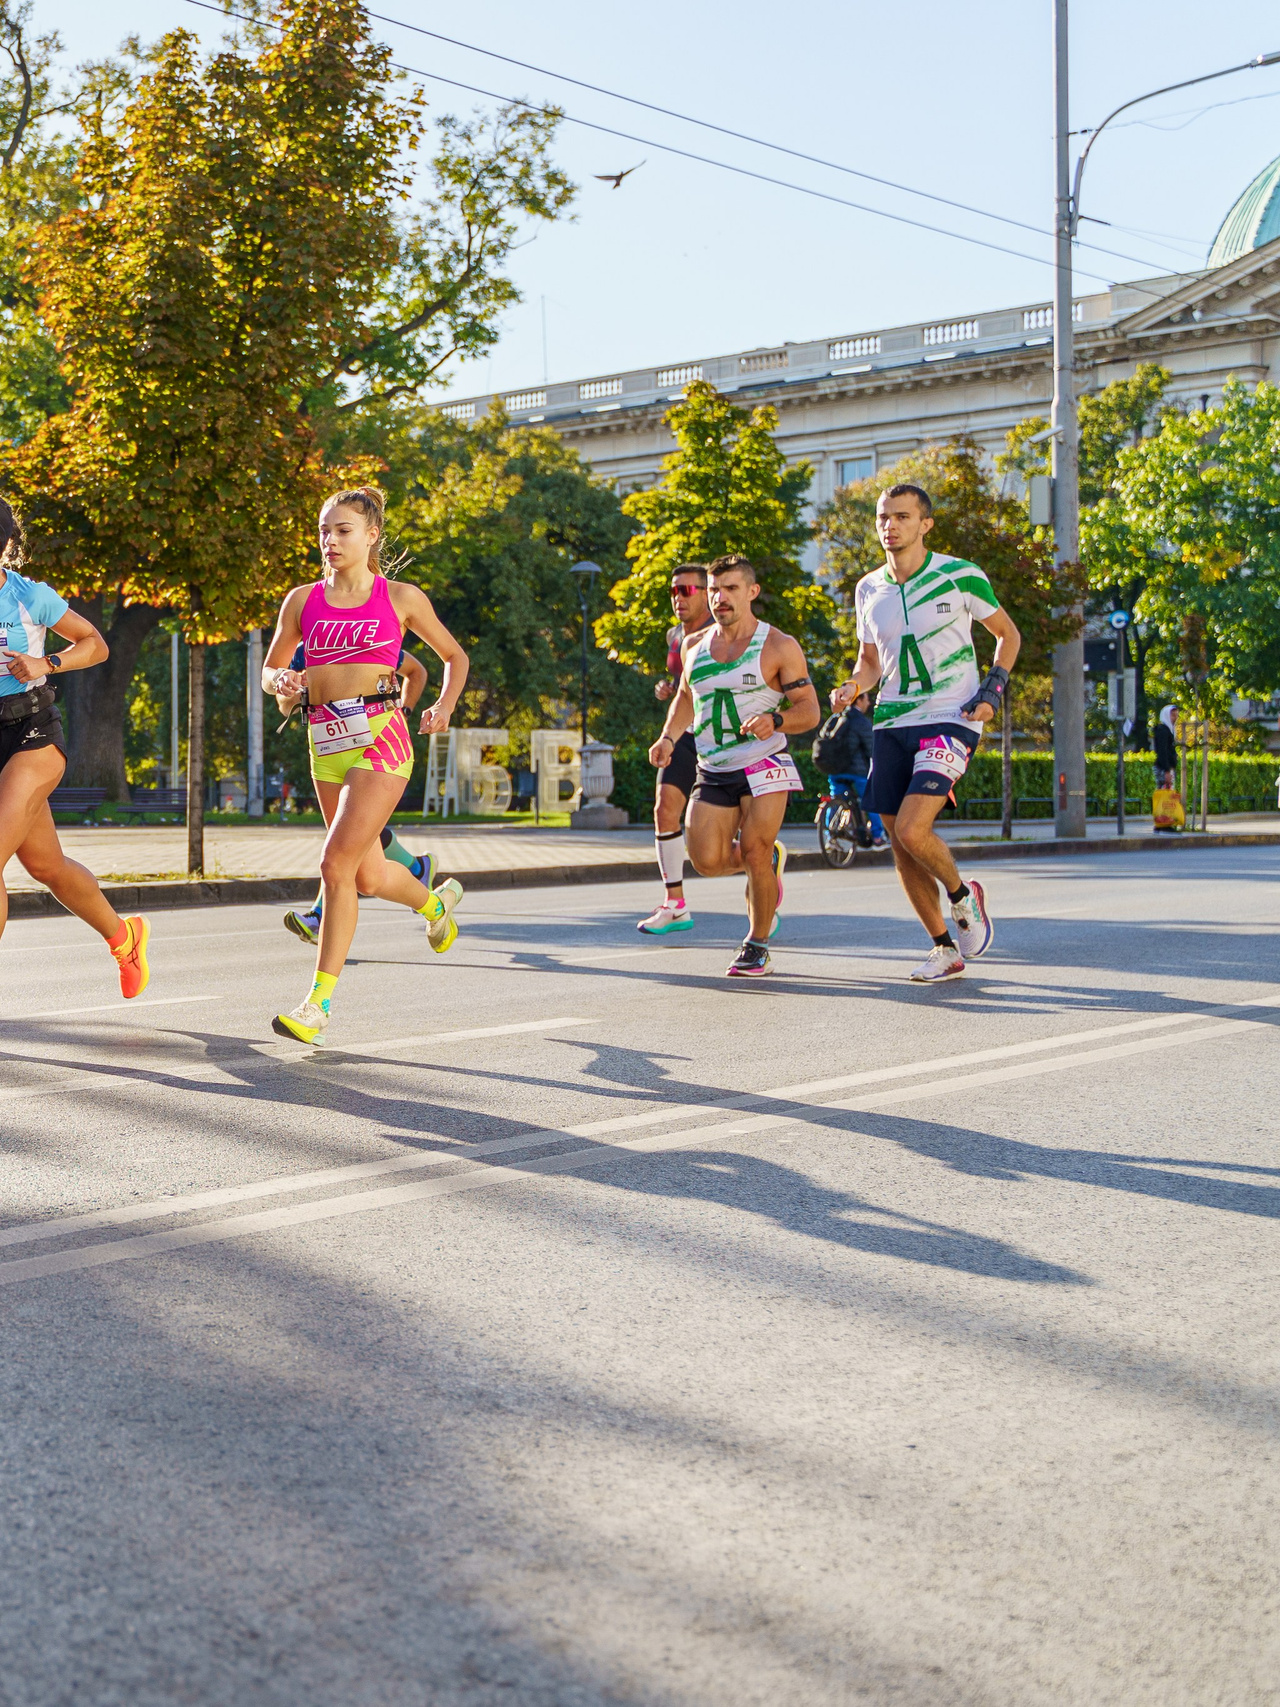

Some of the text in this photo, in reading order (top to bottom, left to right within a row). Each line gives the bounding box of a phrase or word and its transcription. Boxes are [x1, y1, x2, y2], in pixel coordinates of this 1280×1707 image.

[308, 620, 380, 650] NIKE
[899, 633, 933, 695] A
[712, 688, 749, 745] A
[930, 711, 956, 719] running
[325, 720, 349, 737] 611
[925, 749, 955, 763] 560
[765, 768, 788, 780] 471
